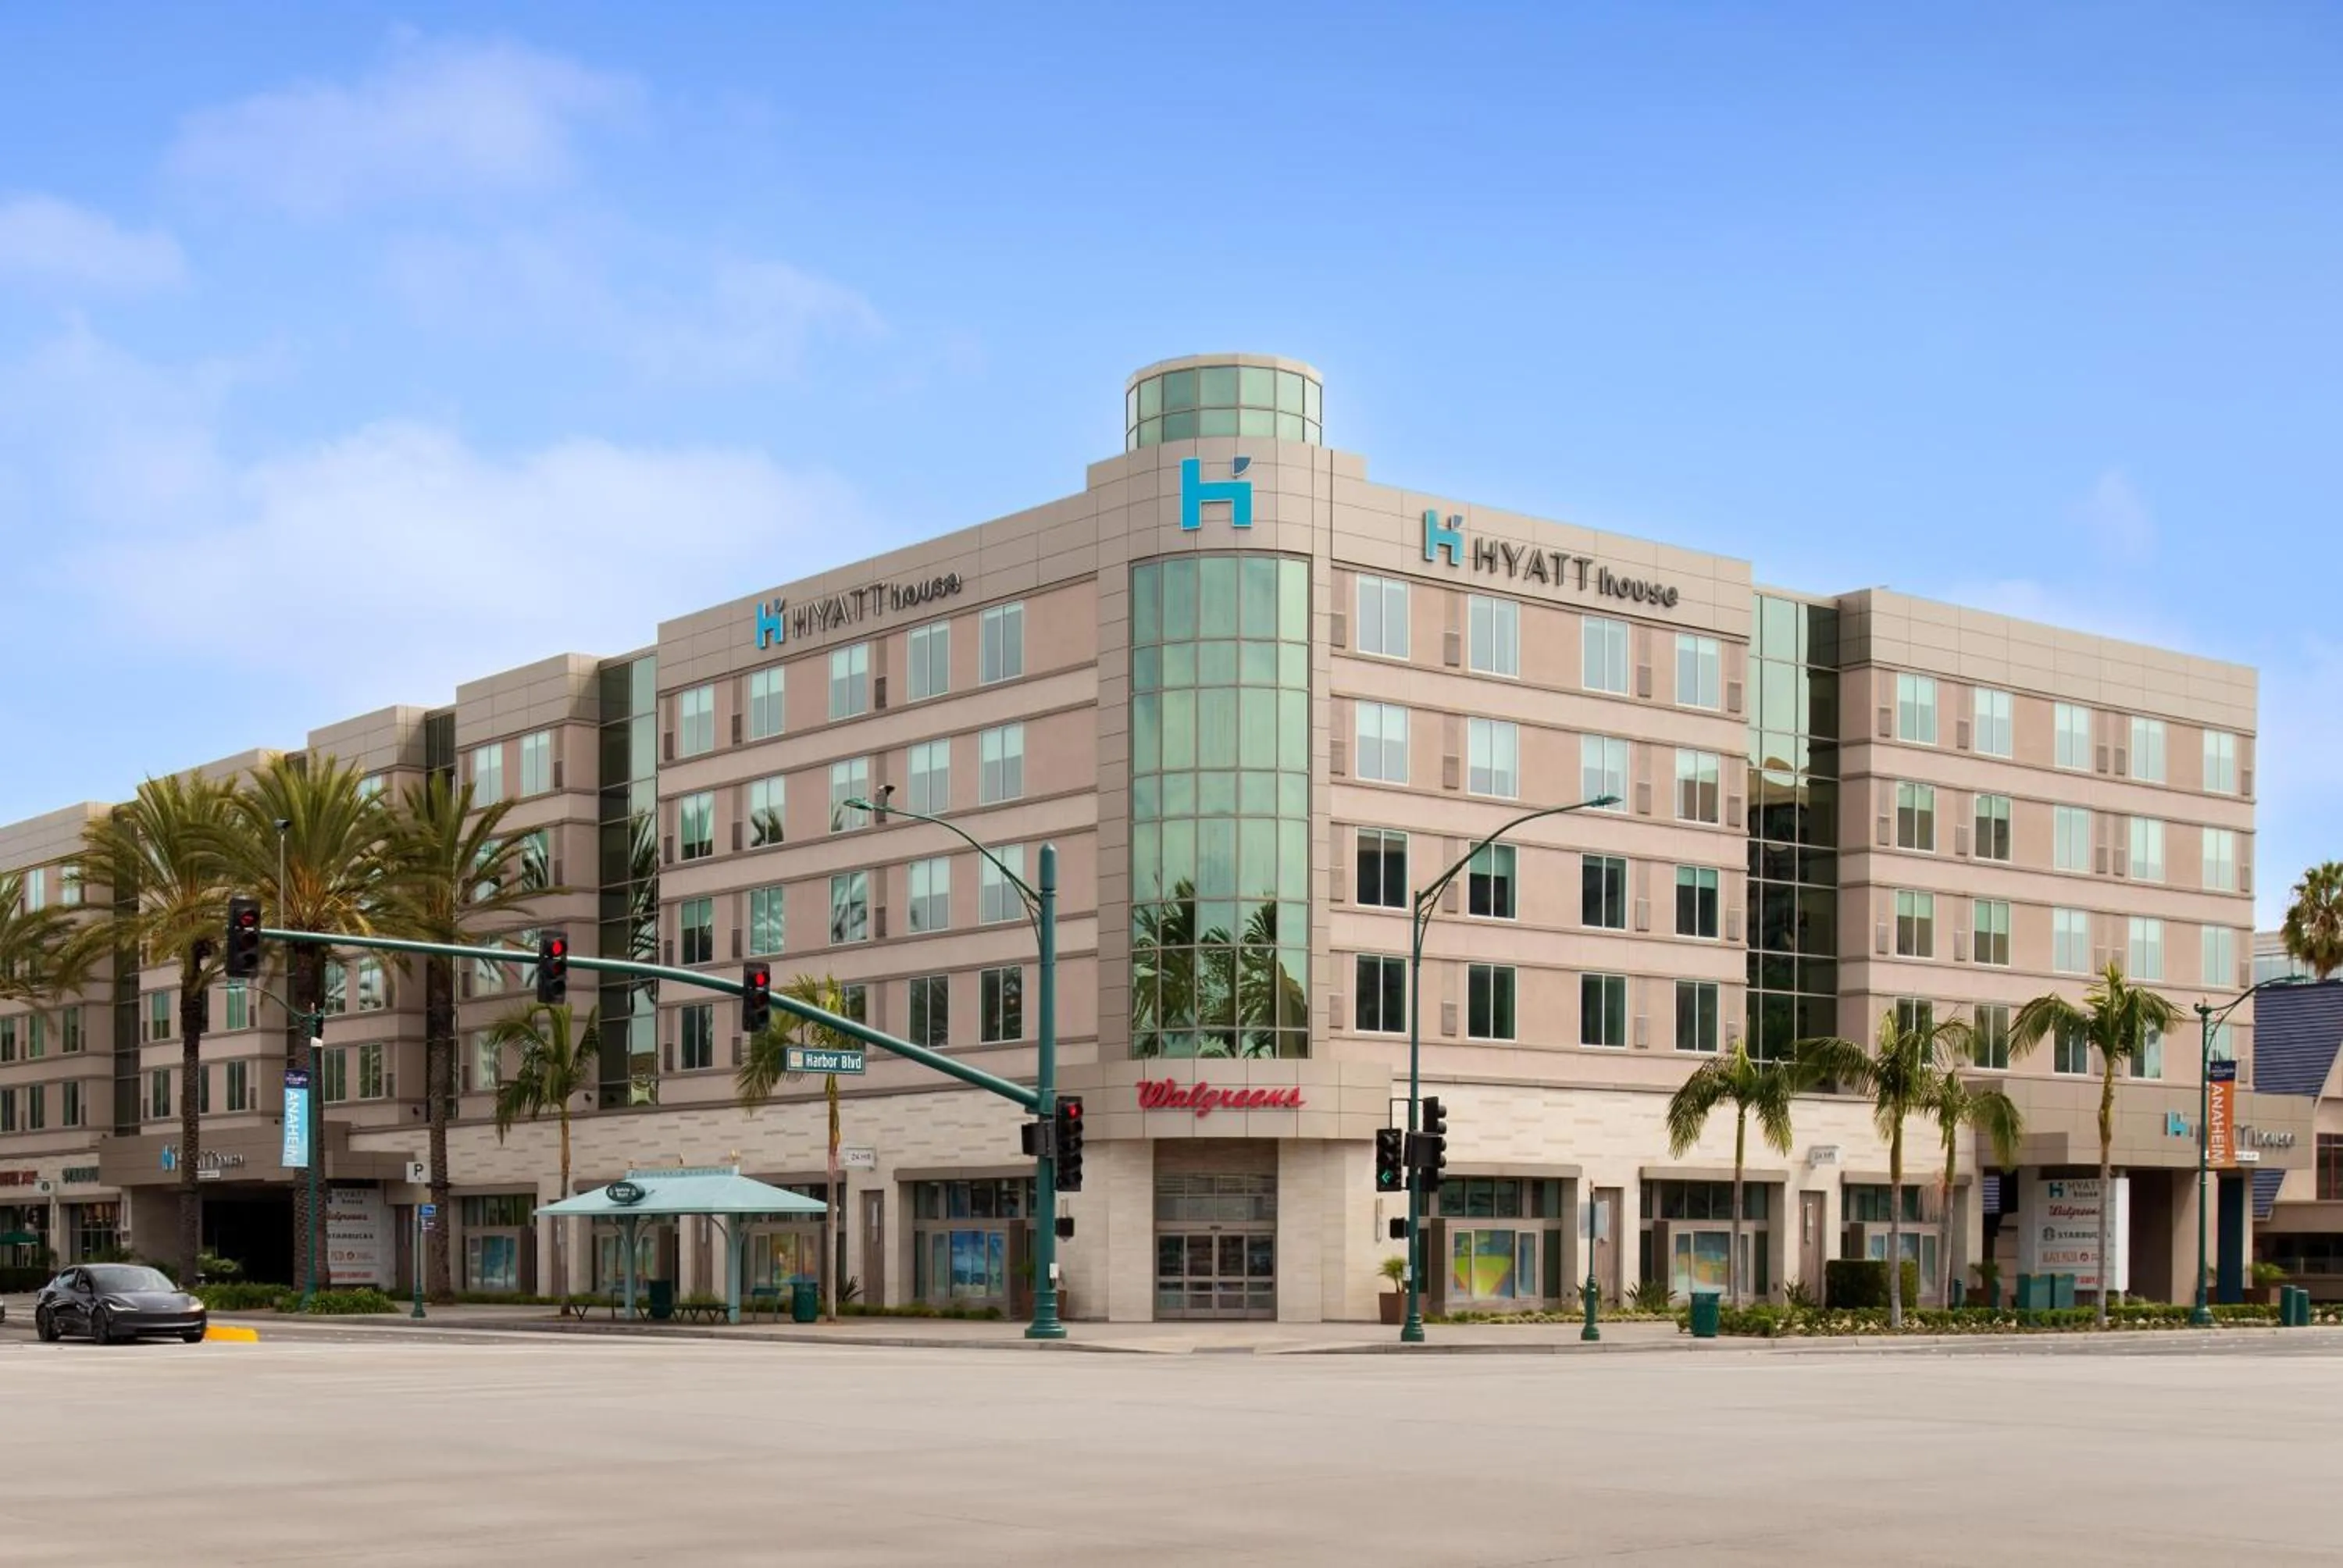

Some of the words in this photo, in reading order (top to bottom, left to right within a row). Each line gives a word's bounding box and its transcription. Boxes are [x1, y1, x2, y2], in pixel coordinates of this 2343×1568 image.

[792, 580, 889, 639] HYATT
[890, 572, 961, 611] house
[1474, 536, 1593, 591] HYATT
[1598, 565, 1678, 608] house
[806, 1053, 837, 1070] Harbor
[841, 1055, 861, 1070] Blvd
[286, 1089, 300, 1164] ANAHEIM
[1135, 1078, 1307, 1119] Walgreens
[2211, 1084, 2225, 1164] ANAHEIM
[414, 1163, 424, 1177] P
